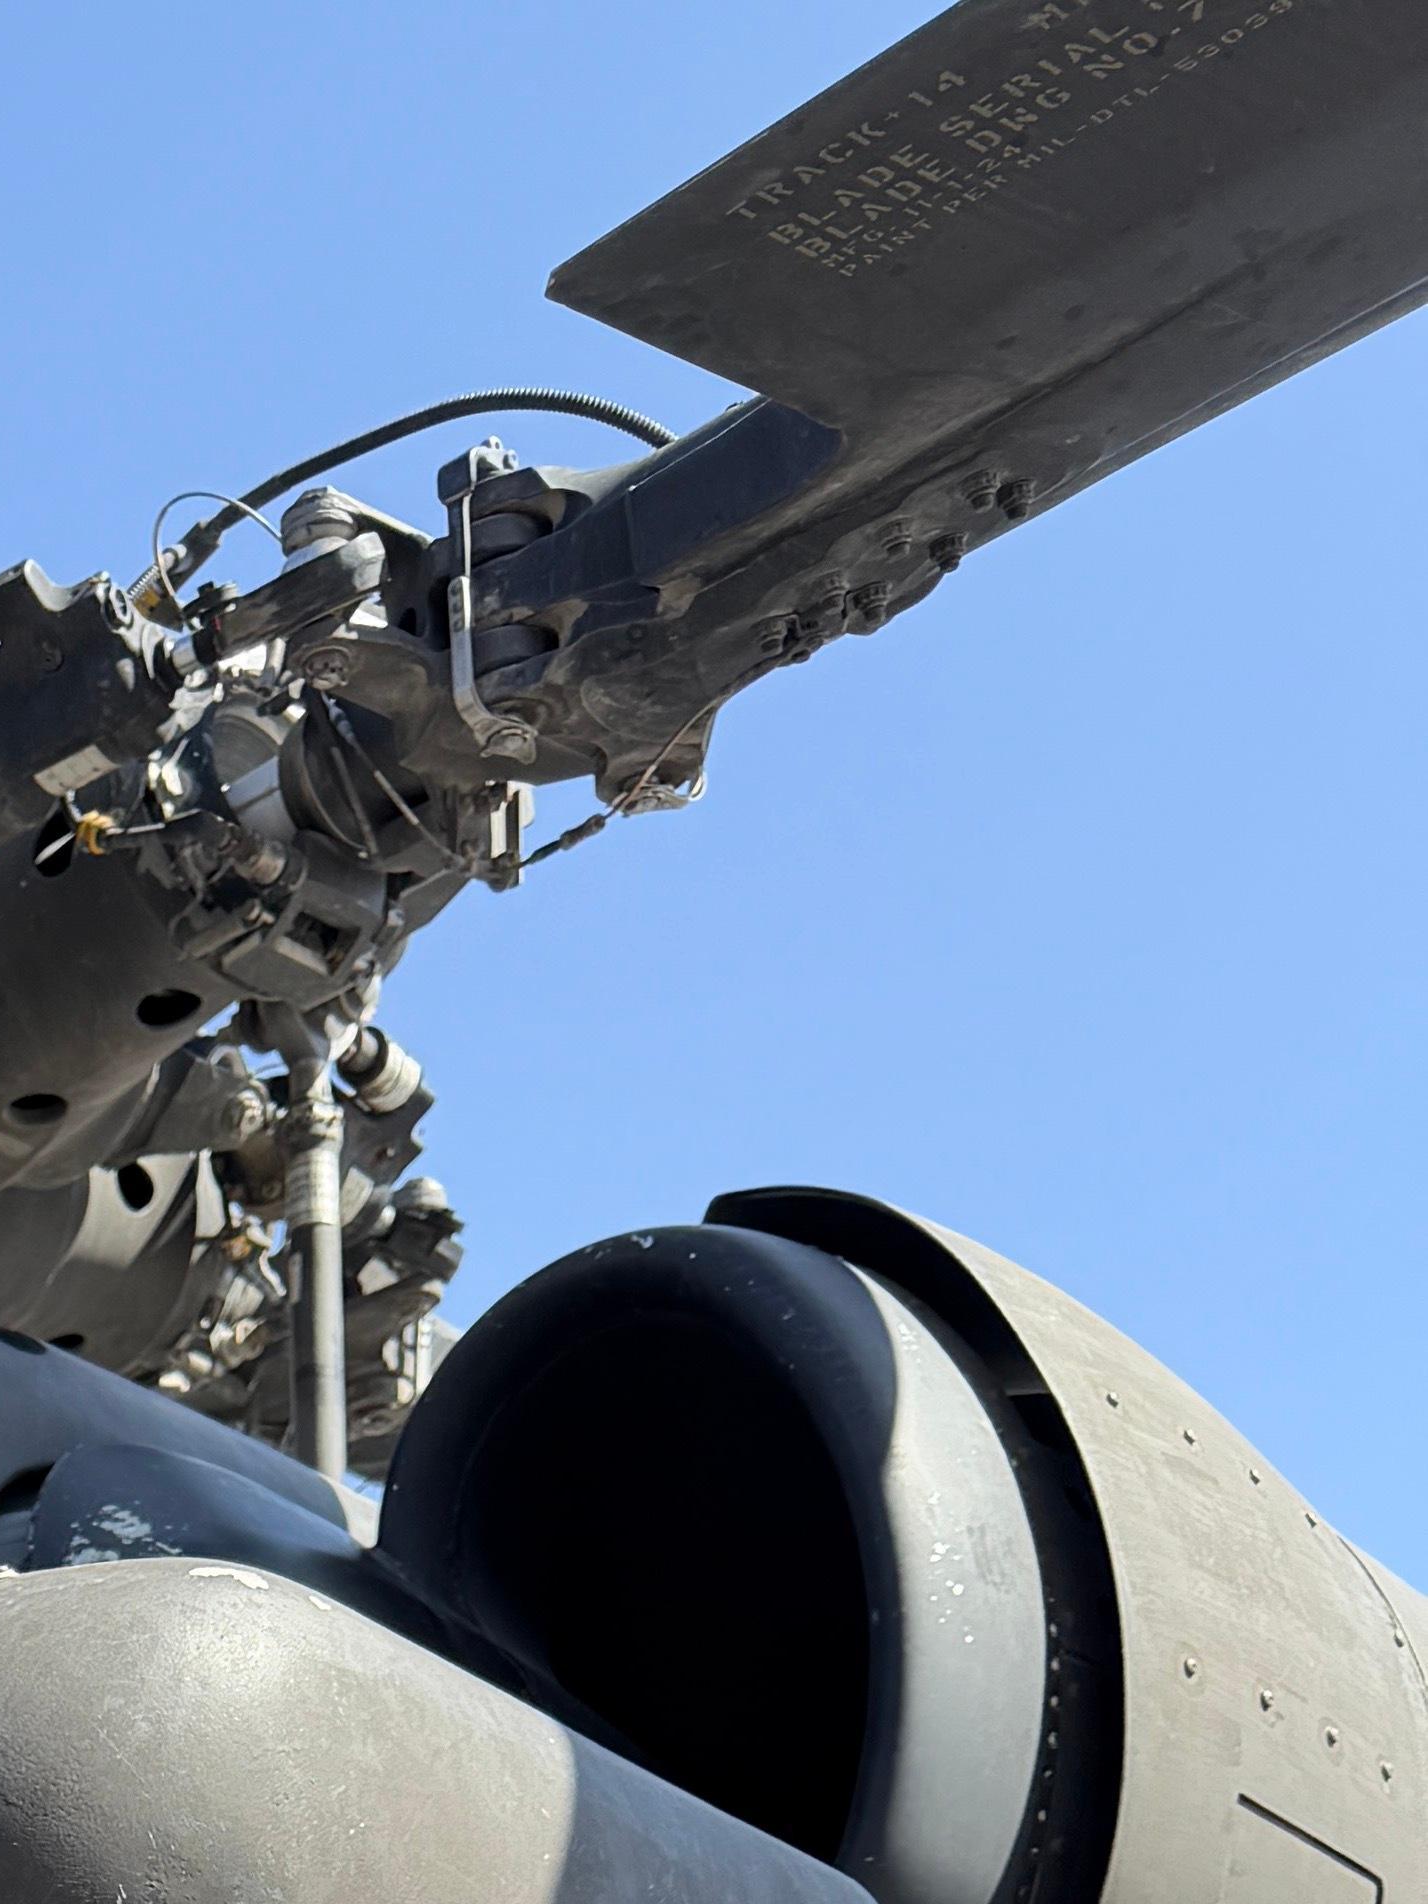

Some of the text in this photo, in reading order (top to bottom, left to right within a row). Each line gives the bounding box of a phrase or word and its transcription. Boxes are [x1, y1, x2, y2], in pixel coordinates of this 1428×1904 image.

[768, 25, 1131, 245] BLADE SERIAL
[795, 158, 956, 258] BLADE
[965, 87, 1072, 153] DWG
[839, 218, 933, 277] PAINT
[942, 173, 1009, 215] PER
